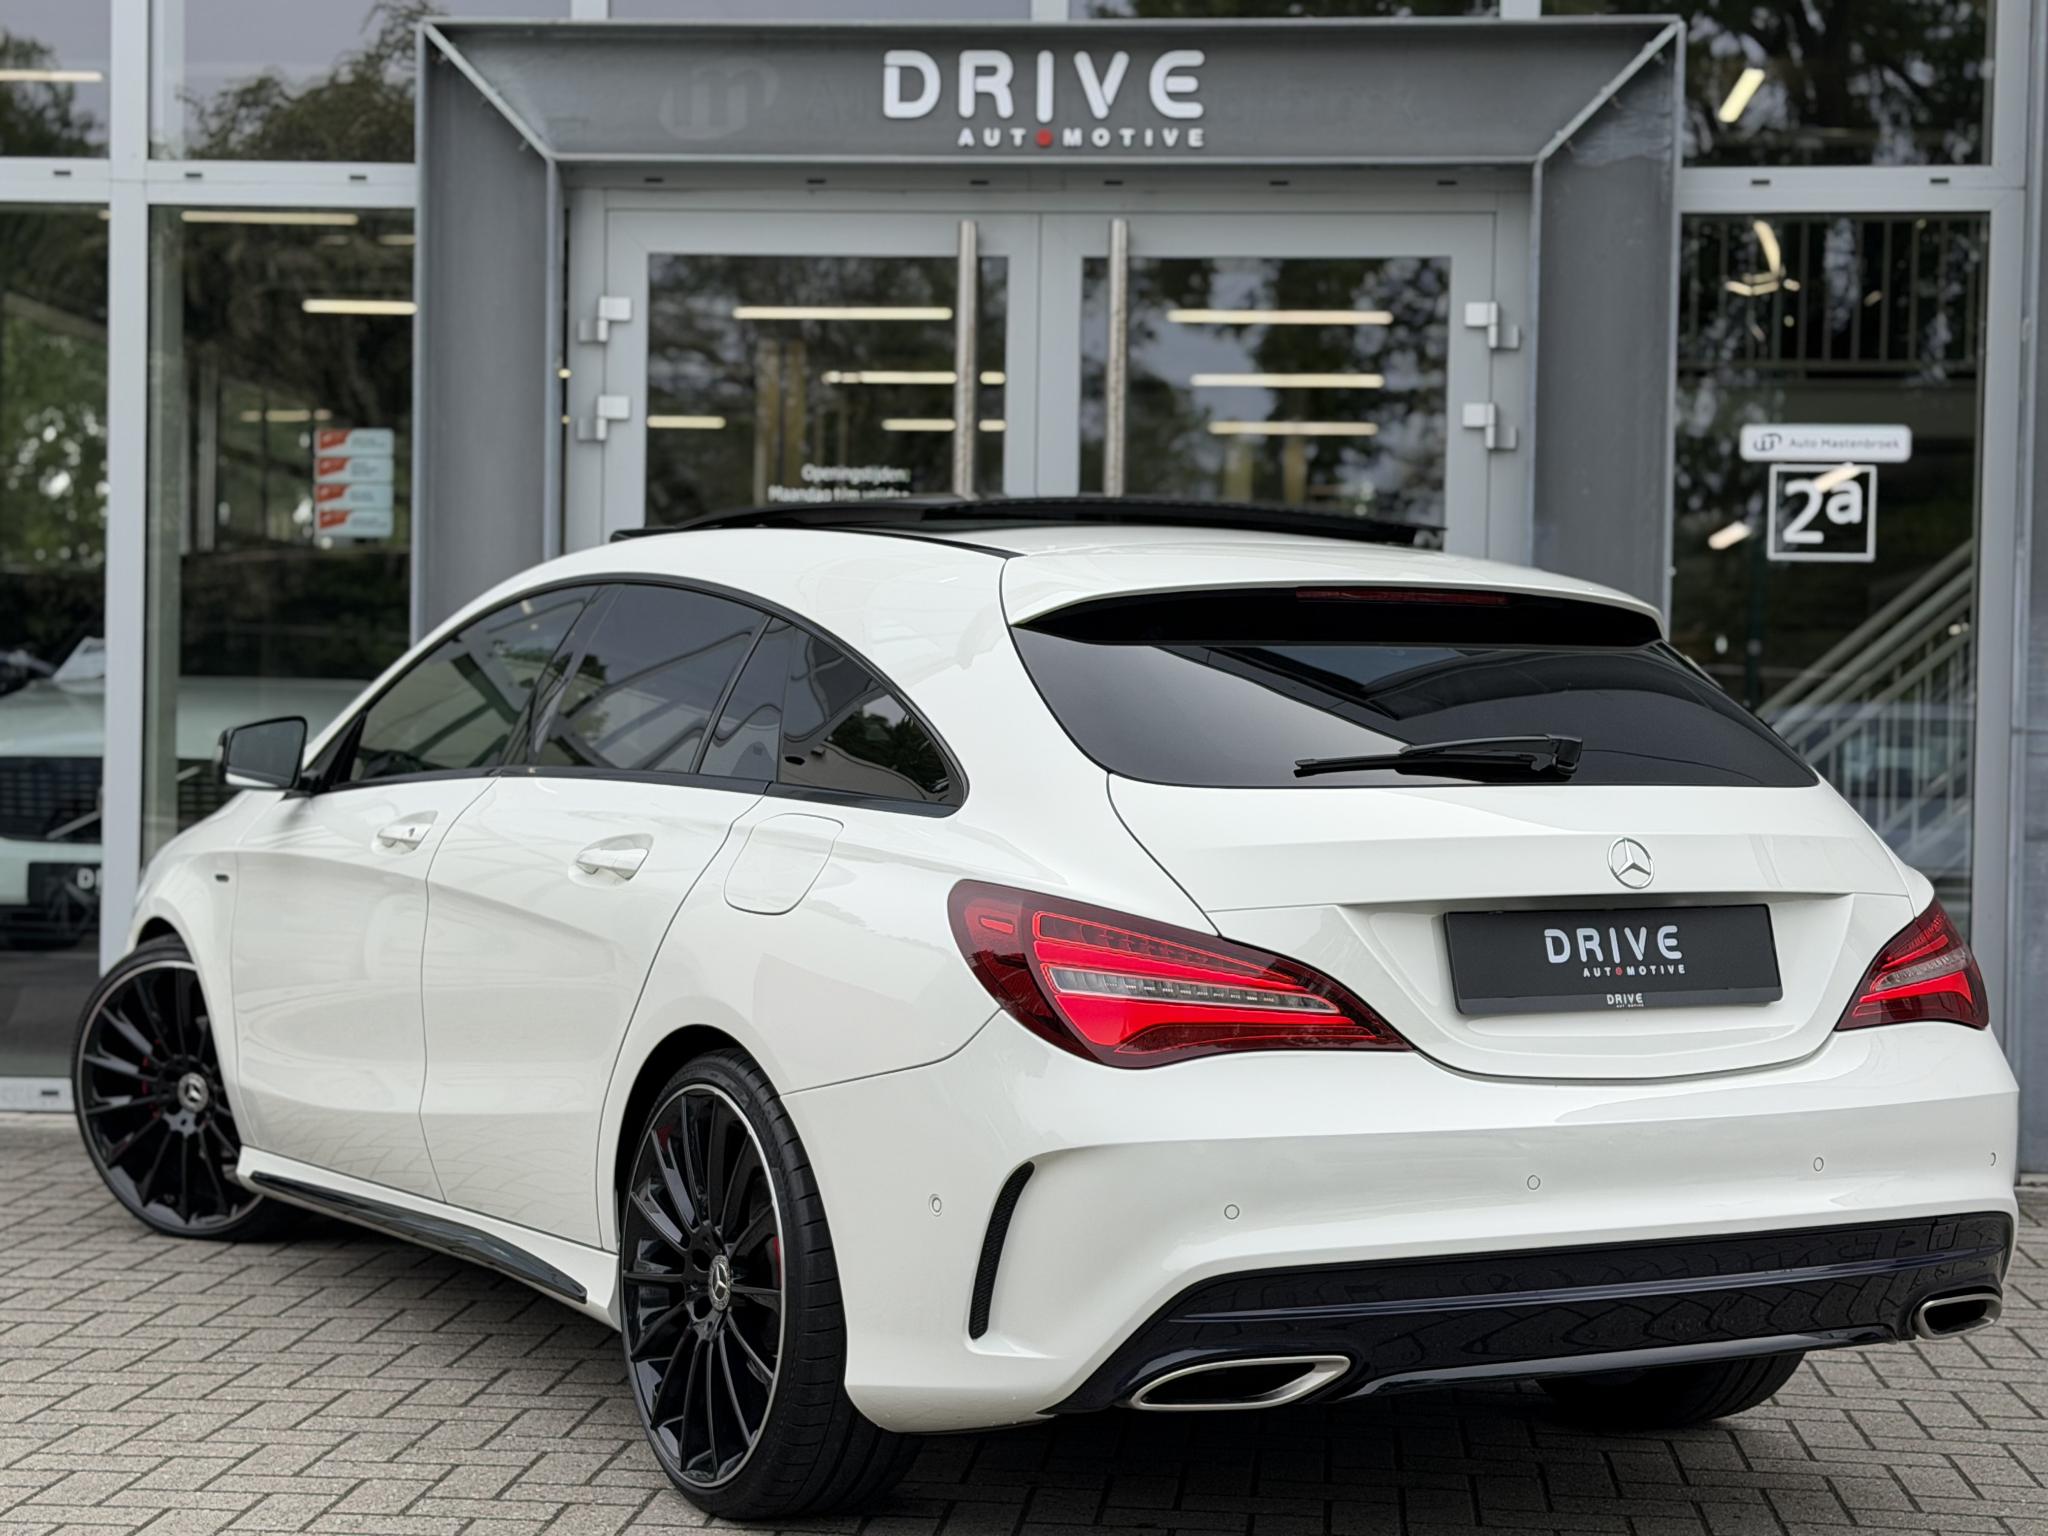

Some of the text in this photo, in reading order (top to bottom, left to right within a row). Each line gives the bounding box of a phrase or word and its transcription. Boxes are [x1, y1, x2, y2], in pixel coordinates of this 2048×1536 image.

[883, 50, 1206, 123] DRIVE
[1789, 436, 1818, 449] Auto
[1783, 478, 1862, 544] 2a
[1544, 925, 1683, 964] DRIVE
[1583, 964, 1686, 978] AUTOMOTIVE
[1606, 992, 1643, 1005] DRIVE
